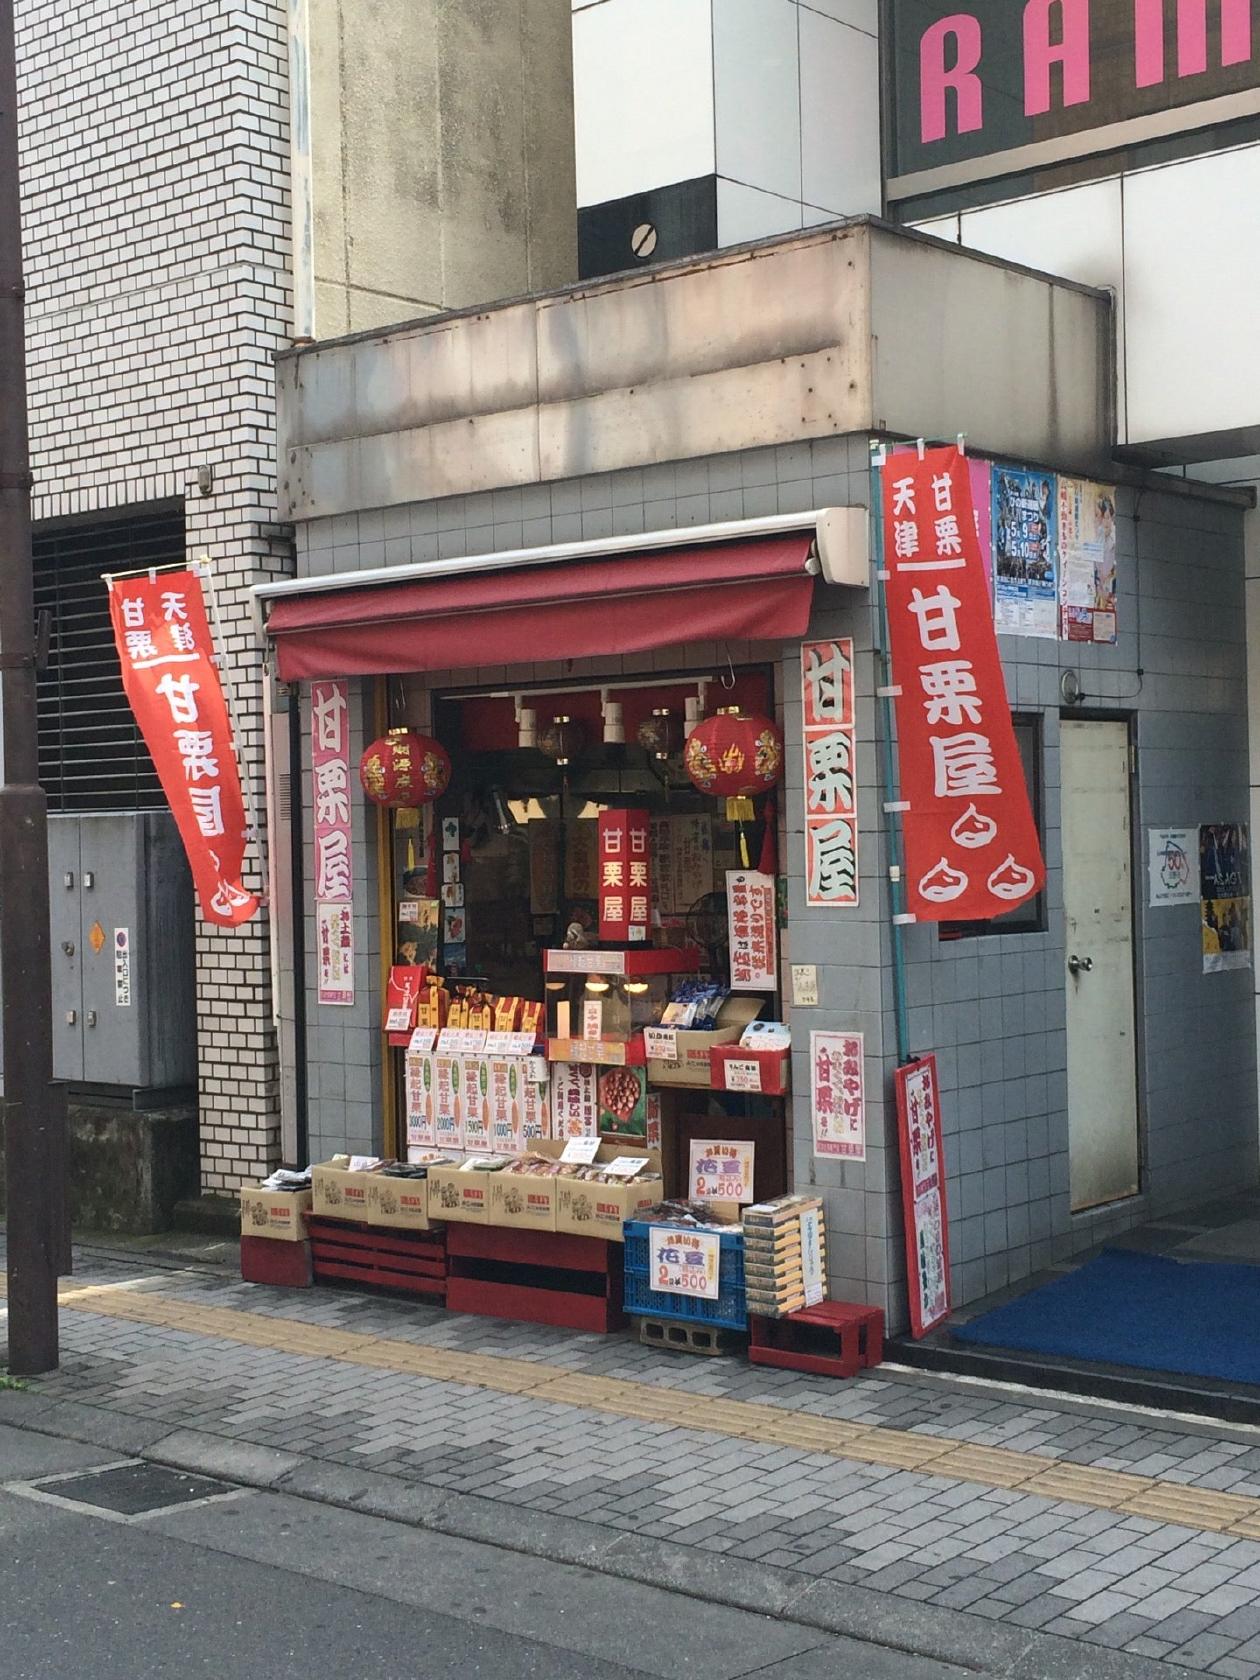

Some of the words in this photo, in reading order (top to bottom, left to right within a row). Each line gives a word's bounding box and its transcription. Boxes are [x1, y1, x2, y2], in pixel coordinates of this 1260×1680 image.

[892, 477, 919, 557] 天津
[931, 472, 962, 556] 甘栗
[907, 584, 1002, 798] 甘栗屋
[313, 683, 351, 899] 甘栗屋
[805, 641, 856, 900] 甘栗屋
[603, 828, 623, 922] 甘栗屋
[629, 828, 648, 922] 甘栗屋
[494, 1123, 513, 1138] 1000円
[523, 1124, 542, 1139] 500円
